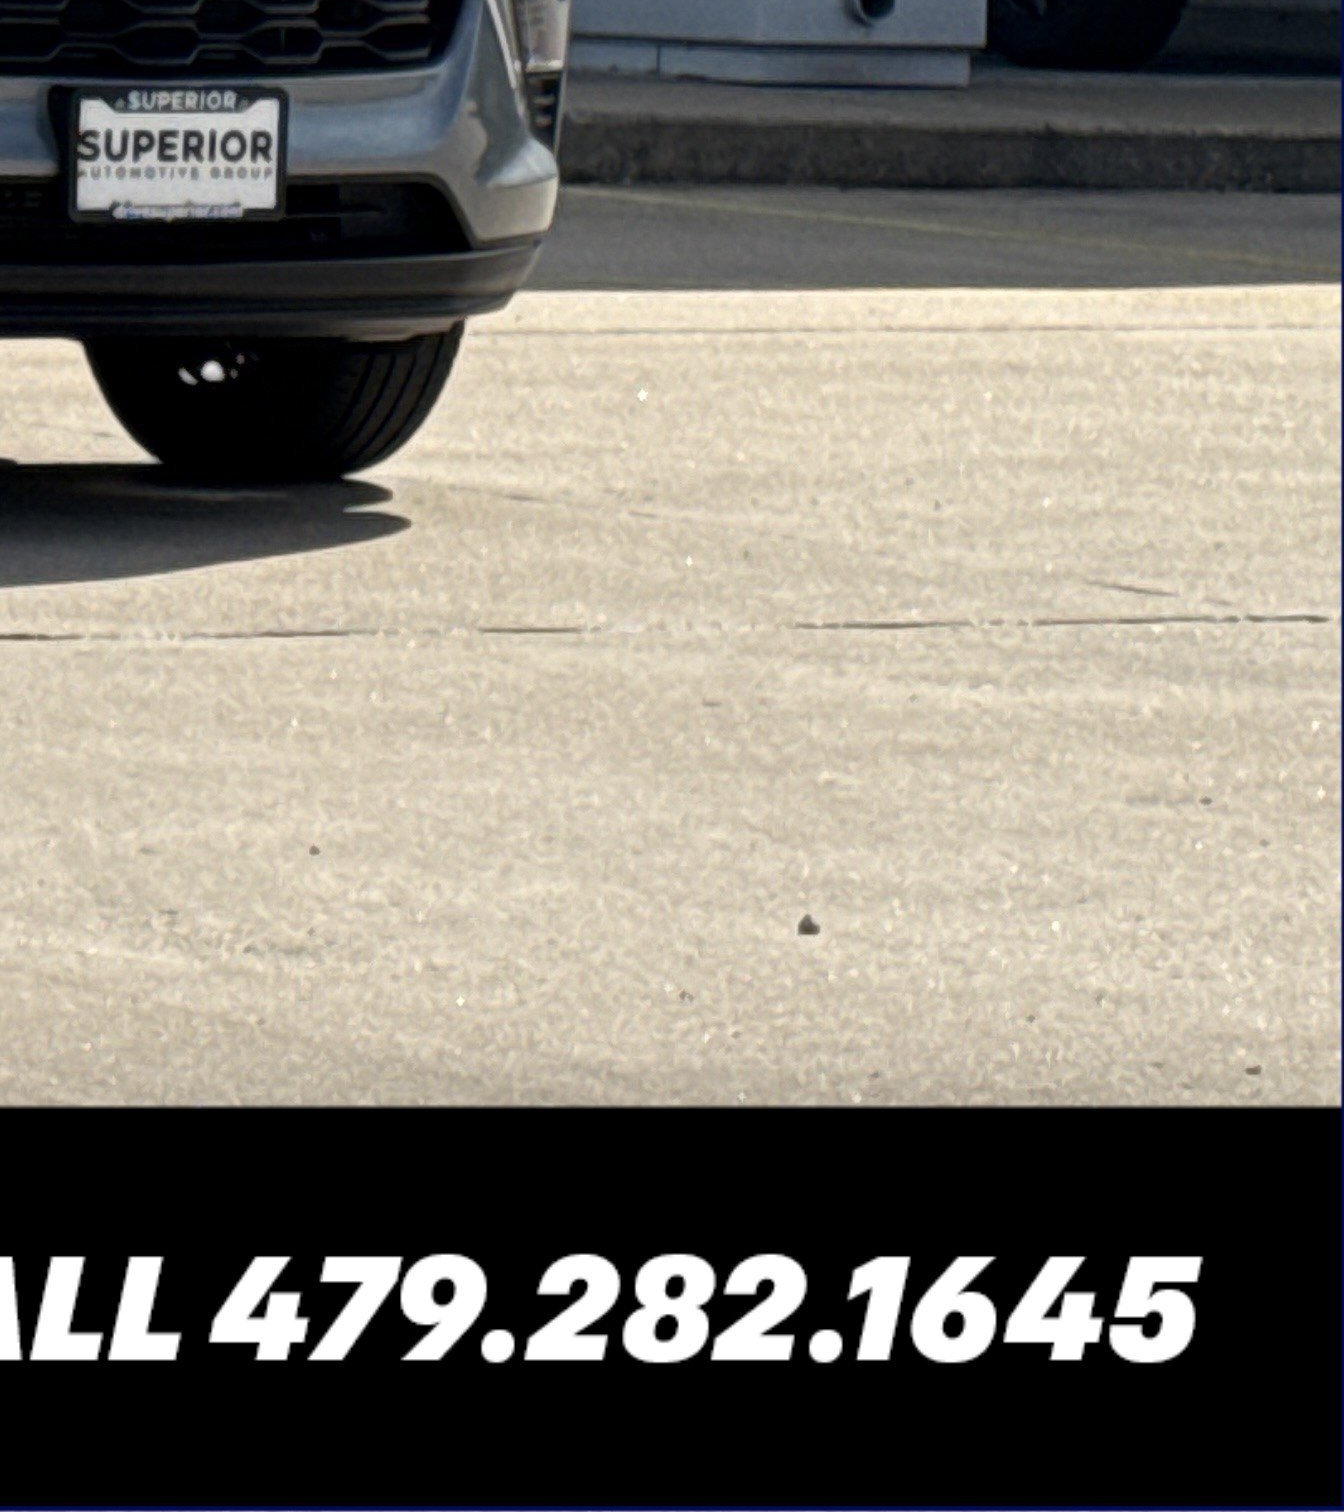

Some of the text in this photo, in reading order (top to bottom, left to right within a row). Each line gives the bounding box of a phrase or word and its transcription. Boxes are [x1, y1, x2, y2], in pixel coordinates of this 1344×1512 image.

[128, 91, 237, 110] SUPERIOR
[78, 128, 273, 164] SUPERIOR
[209, 166, 273, 181] GROUP
